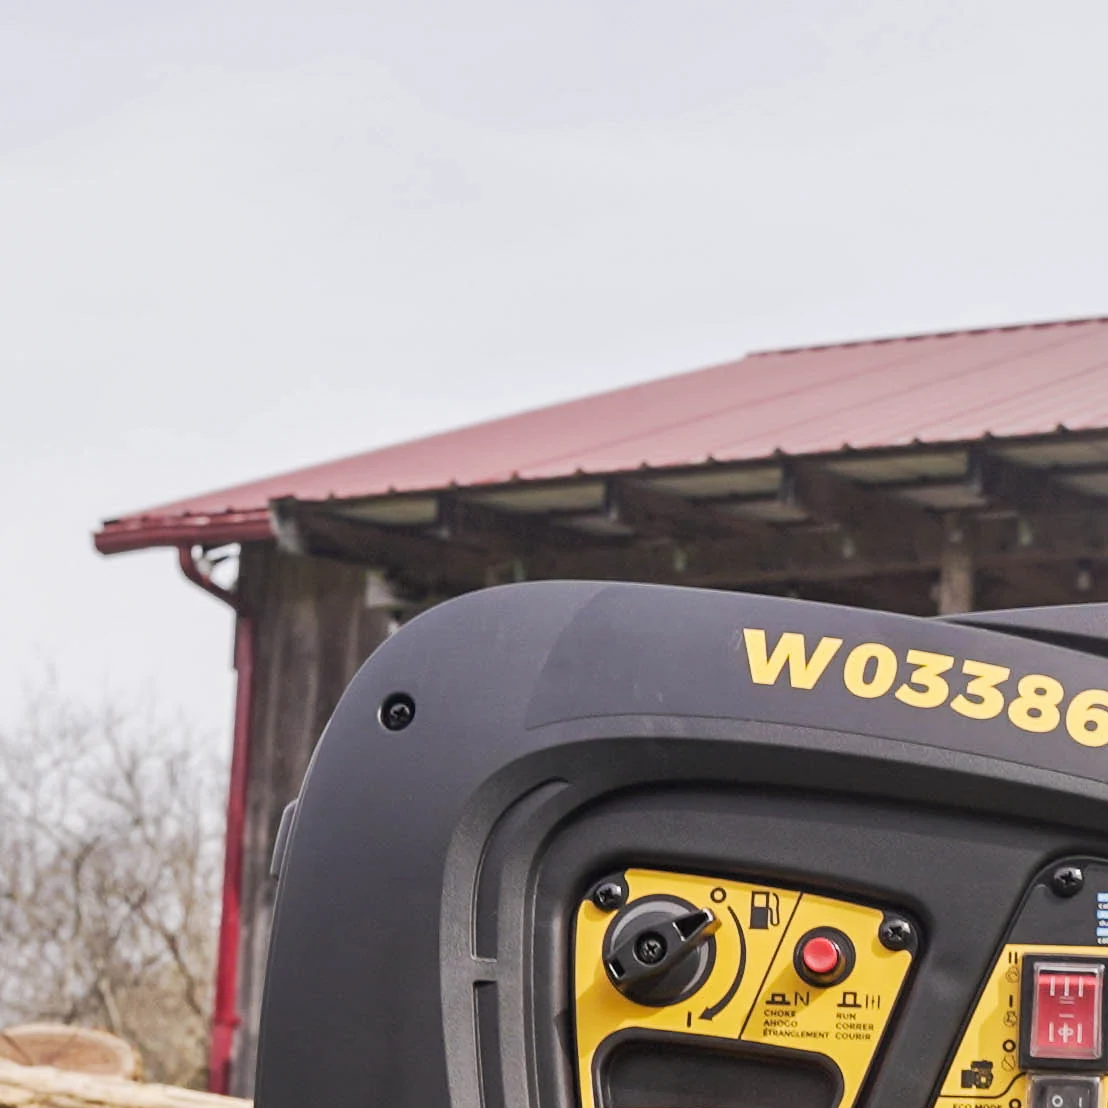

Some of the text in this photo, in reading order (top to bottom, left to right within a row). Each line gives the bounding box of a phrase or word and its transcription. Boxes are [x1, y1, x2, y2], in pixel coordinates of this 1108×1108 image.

[763, 1009, 797, 1018] CHOKE
[836, 1012, 857, 1021] RUN
[763, 1019, 798, 1028] AHOGO
[835, 1021, 875, 1031] CORRER
